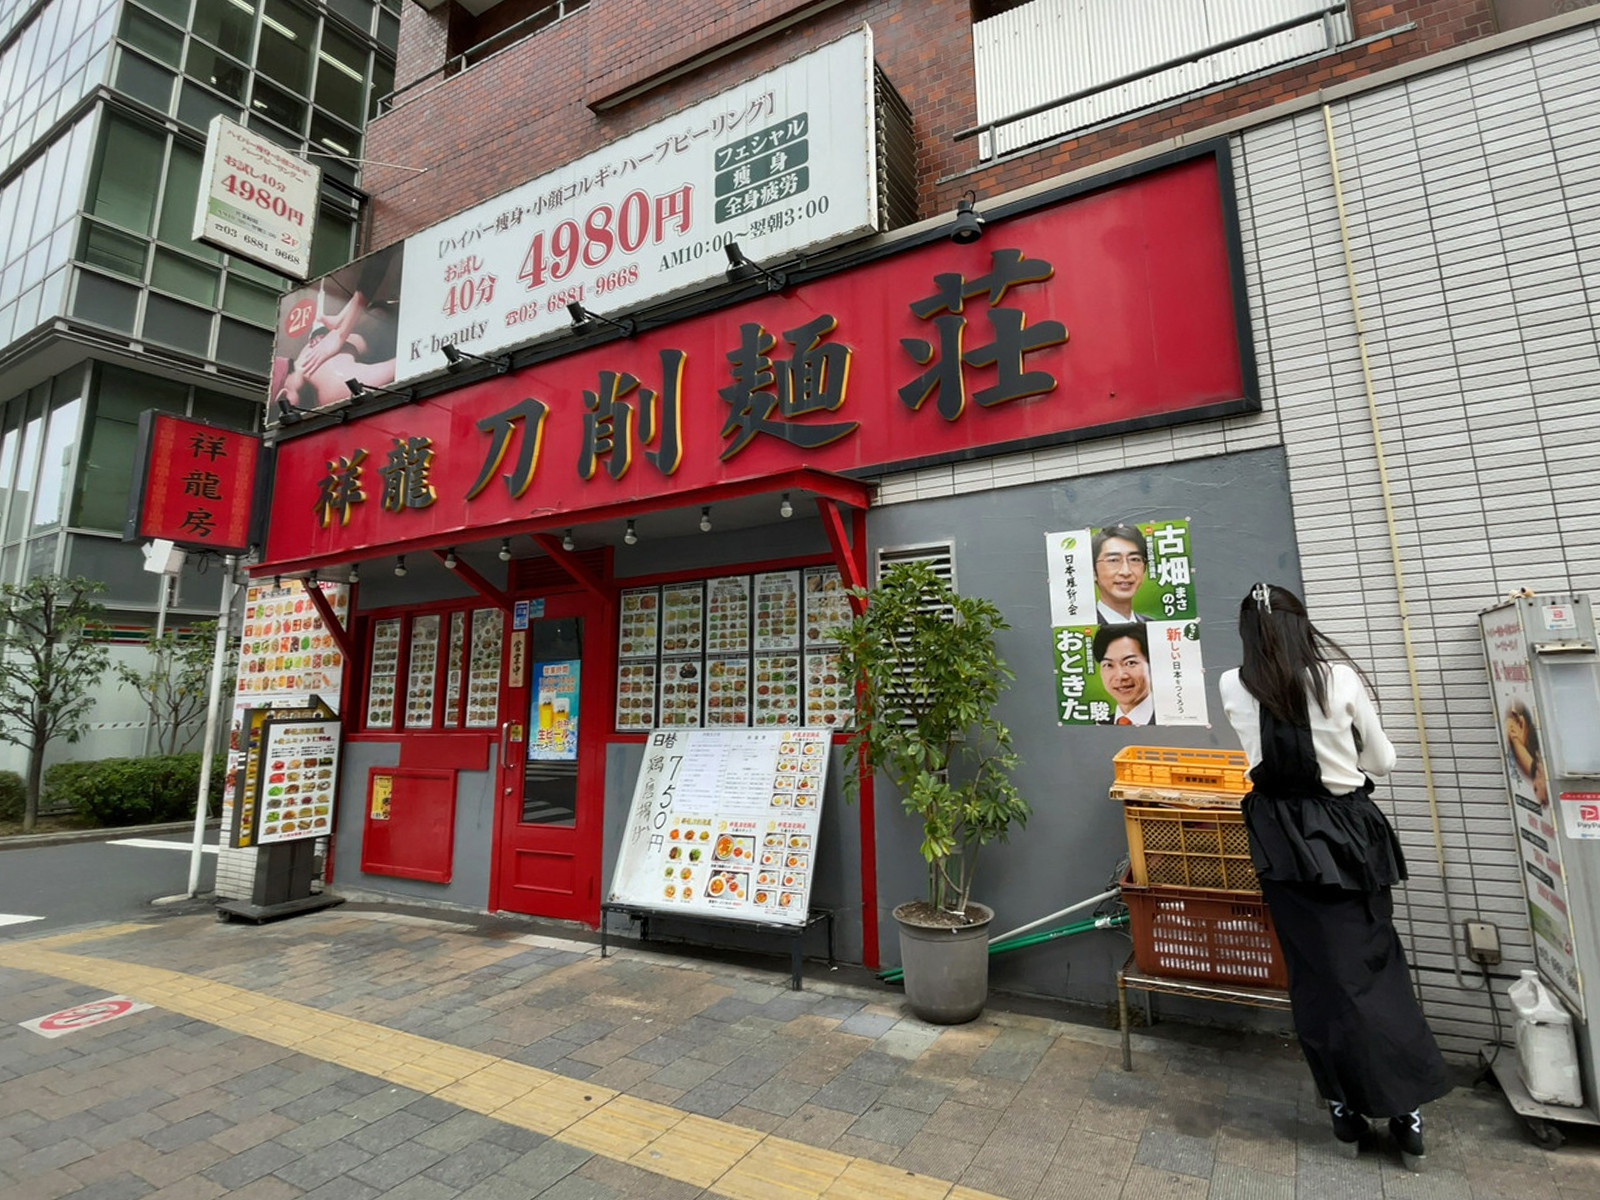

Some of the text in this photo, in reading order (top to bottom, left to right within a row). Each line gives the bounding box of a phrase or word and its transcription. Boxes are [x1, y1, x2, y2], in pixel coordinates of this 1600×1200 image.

[718, 119, 805, 168] フェシャル
[224, 155, 286, 192] お試し40分
[724, 173, 799, 218] 全身疲労
[221, 174, 304, 227] 4980円
[281, 231, 299, 247] 2F
[517, 182, 695, 291] 4980円
[444, 255, 484, 282] お試し
[288, 306, 313, 334] 2F
[442, 275, 497, 318] 40分
[179, 431, 228, 537] 祥龍房
[1154, 525, 1190, 586] 古畑
[1064, 554, 1078, 616] 日本維新の会
[512, 640, 523, 676] 営業中
[1056, 630, 1089, 720] おときた
[1165, 627, 1184, 714] 新しい日本をつくろう
[653, 732, 677, 749] 日替
